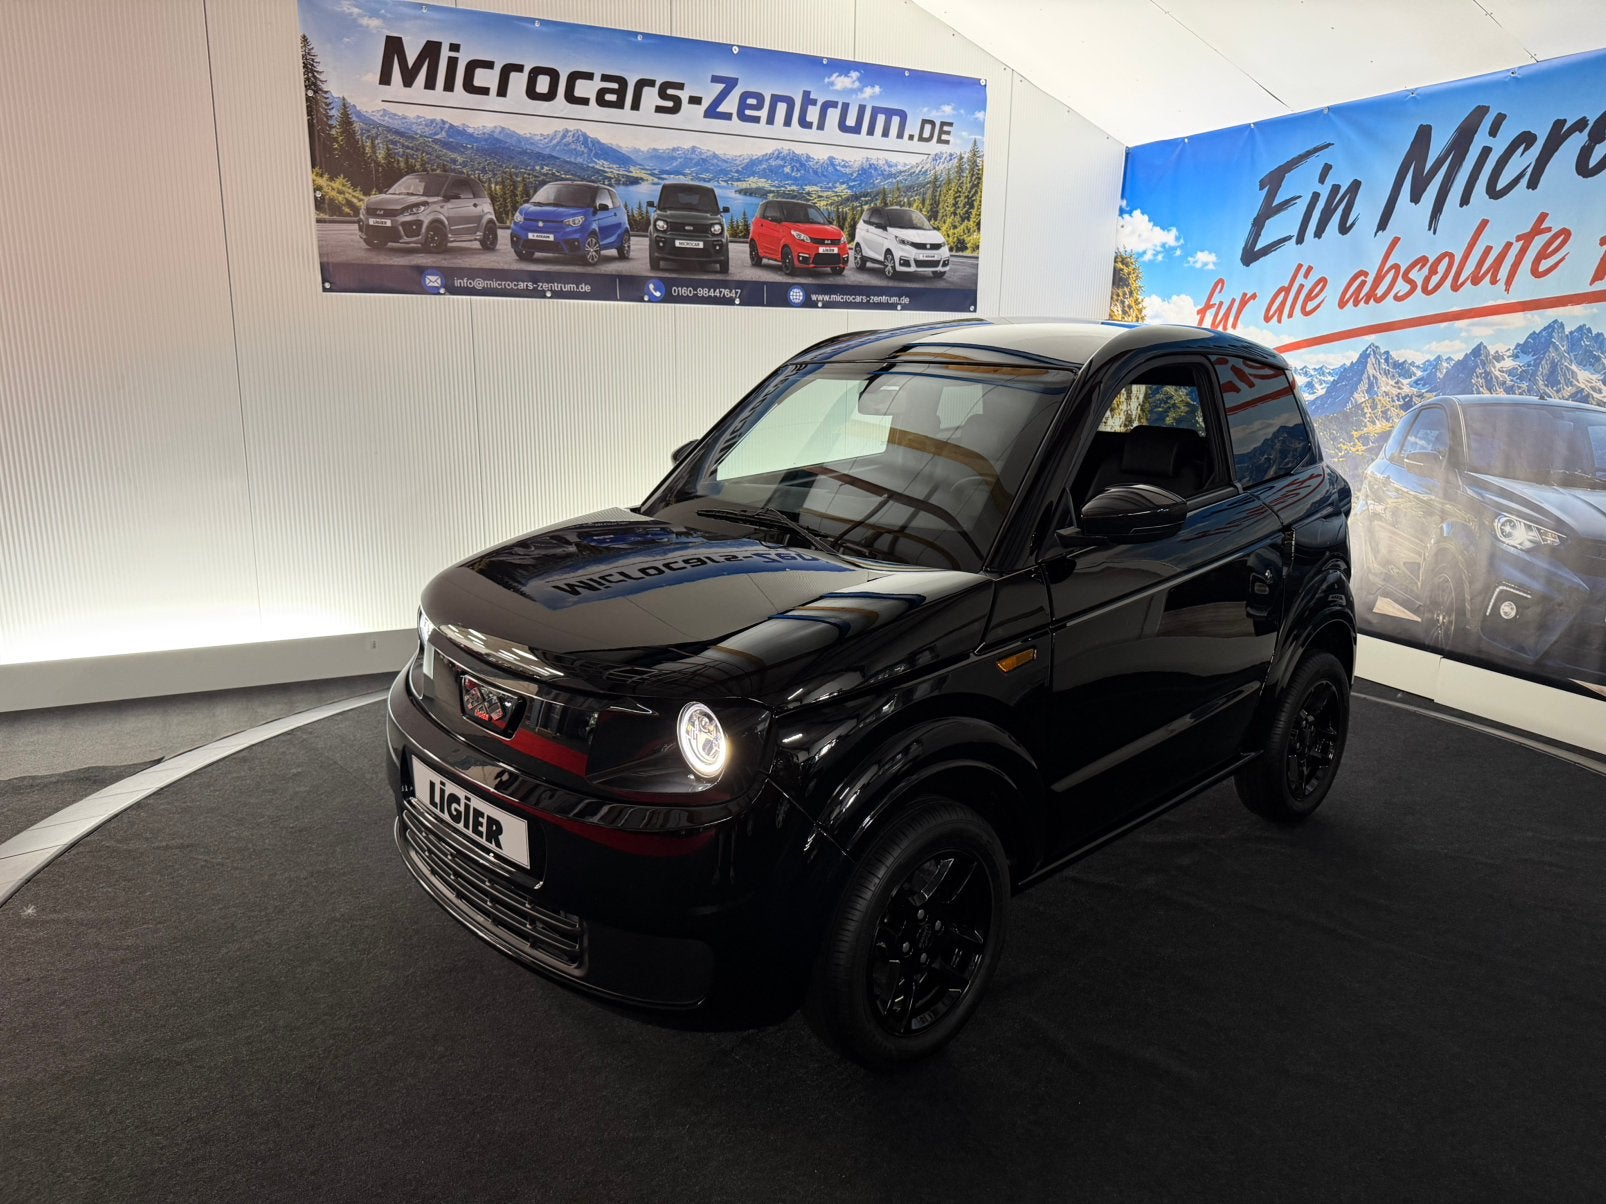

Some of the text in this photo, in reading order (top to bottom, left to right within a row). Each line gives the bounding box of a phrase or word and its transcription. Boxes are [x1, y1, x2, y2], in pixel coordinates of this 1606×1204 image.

[378, 35, 954, 145] Microcars-Zentrum.DE
[1240, 142, 1362, 267] Ein
[454, 277, 591, 293] info@microcars-zentrum.de
[671, 286, 741, 299] 0160-98447647
[811, 292, 910, 305] www.microcars-zentrum.de
[1263, 263, 1329, 324] die
[1337, 212, 1572, 306] absolute
